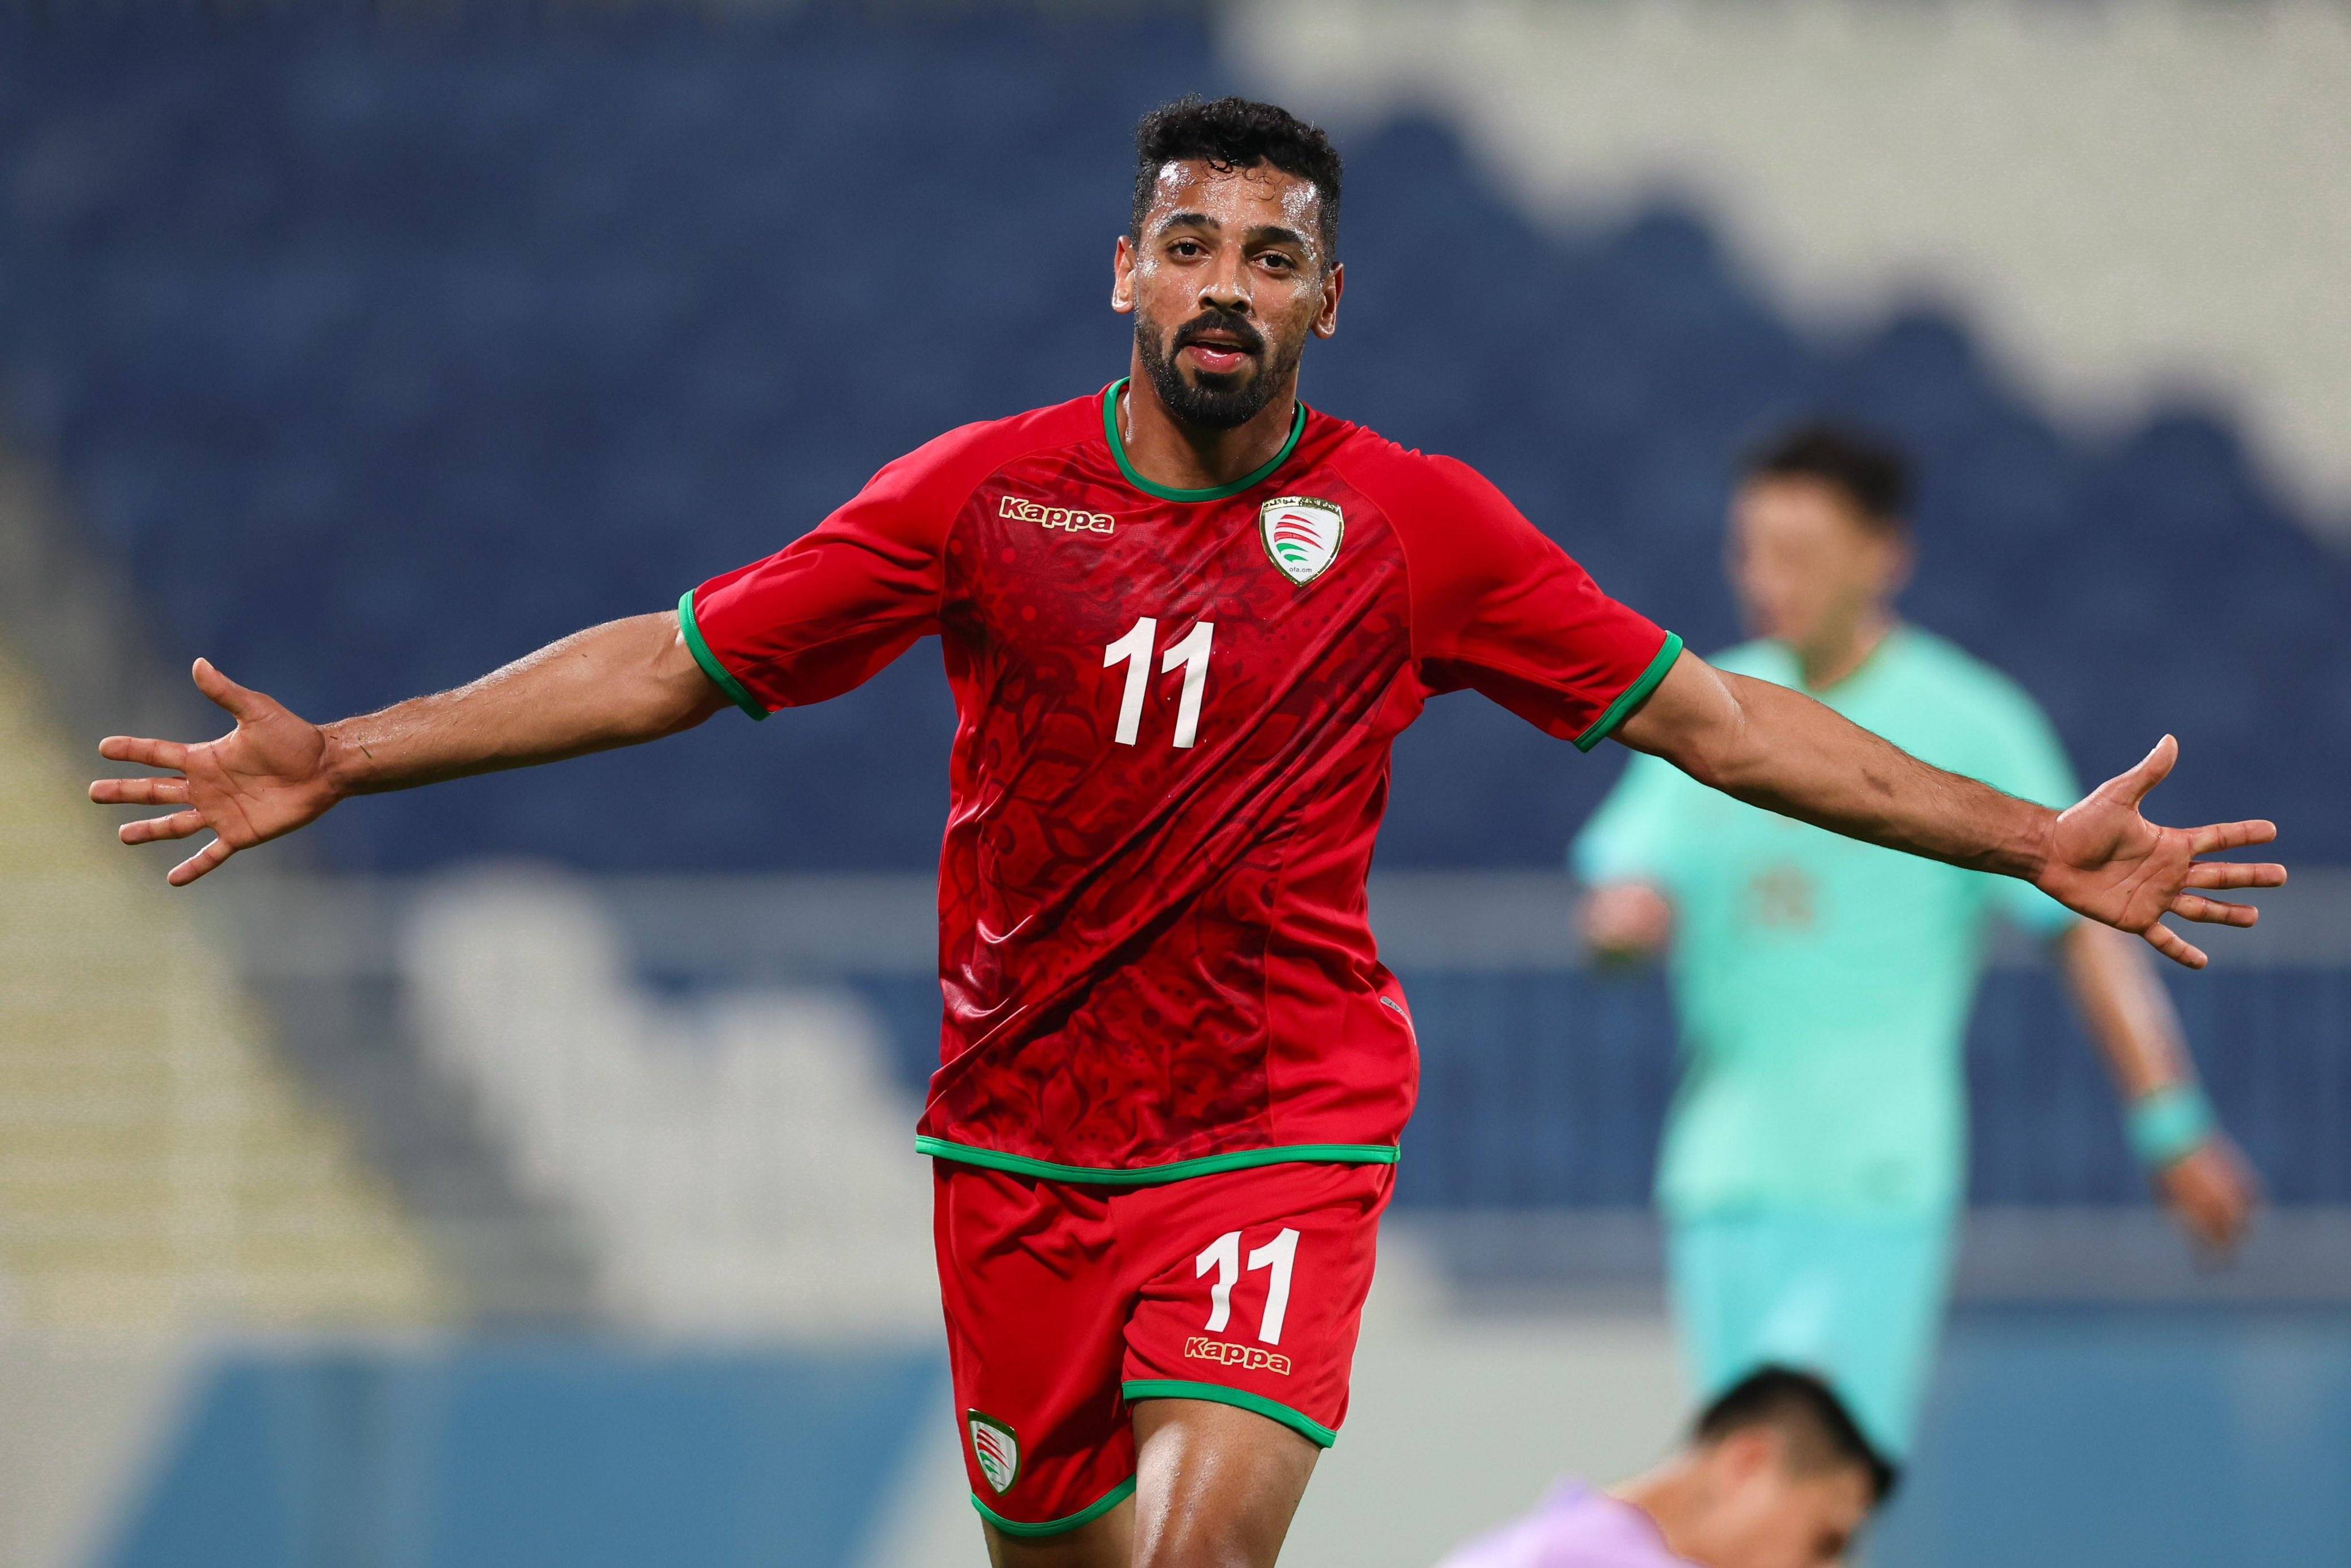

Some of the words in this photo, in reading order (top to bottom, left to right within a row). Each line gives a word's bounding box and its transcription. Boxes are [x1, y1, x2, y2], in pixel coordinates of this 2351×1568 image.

[999, 495, 1115, 534] Kappa
[1103, 616, 1215, 748] 11
[1196, 1227, 1300, 1346] 11
[1184, 1337, 1291, 1376] Kappa
